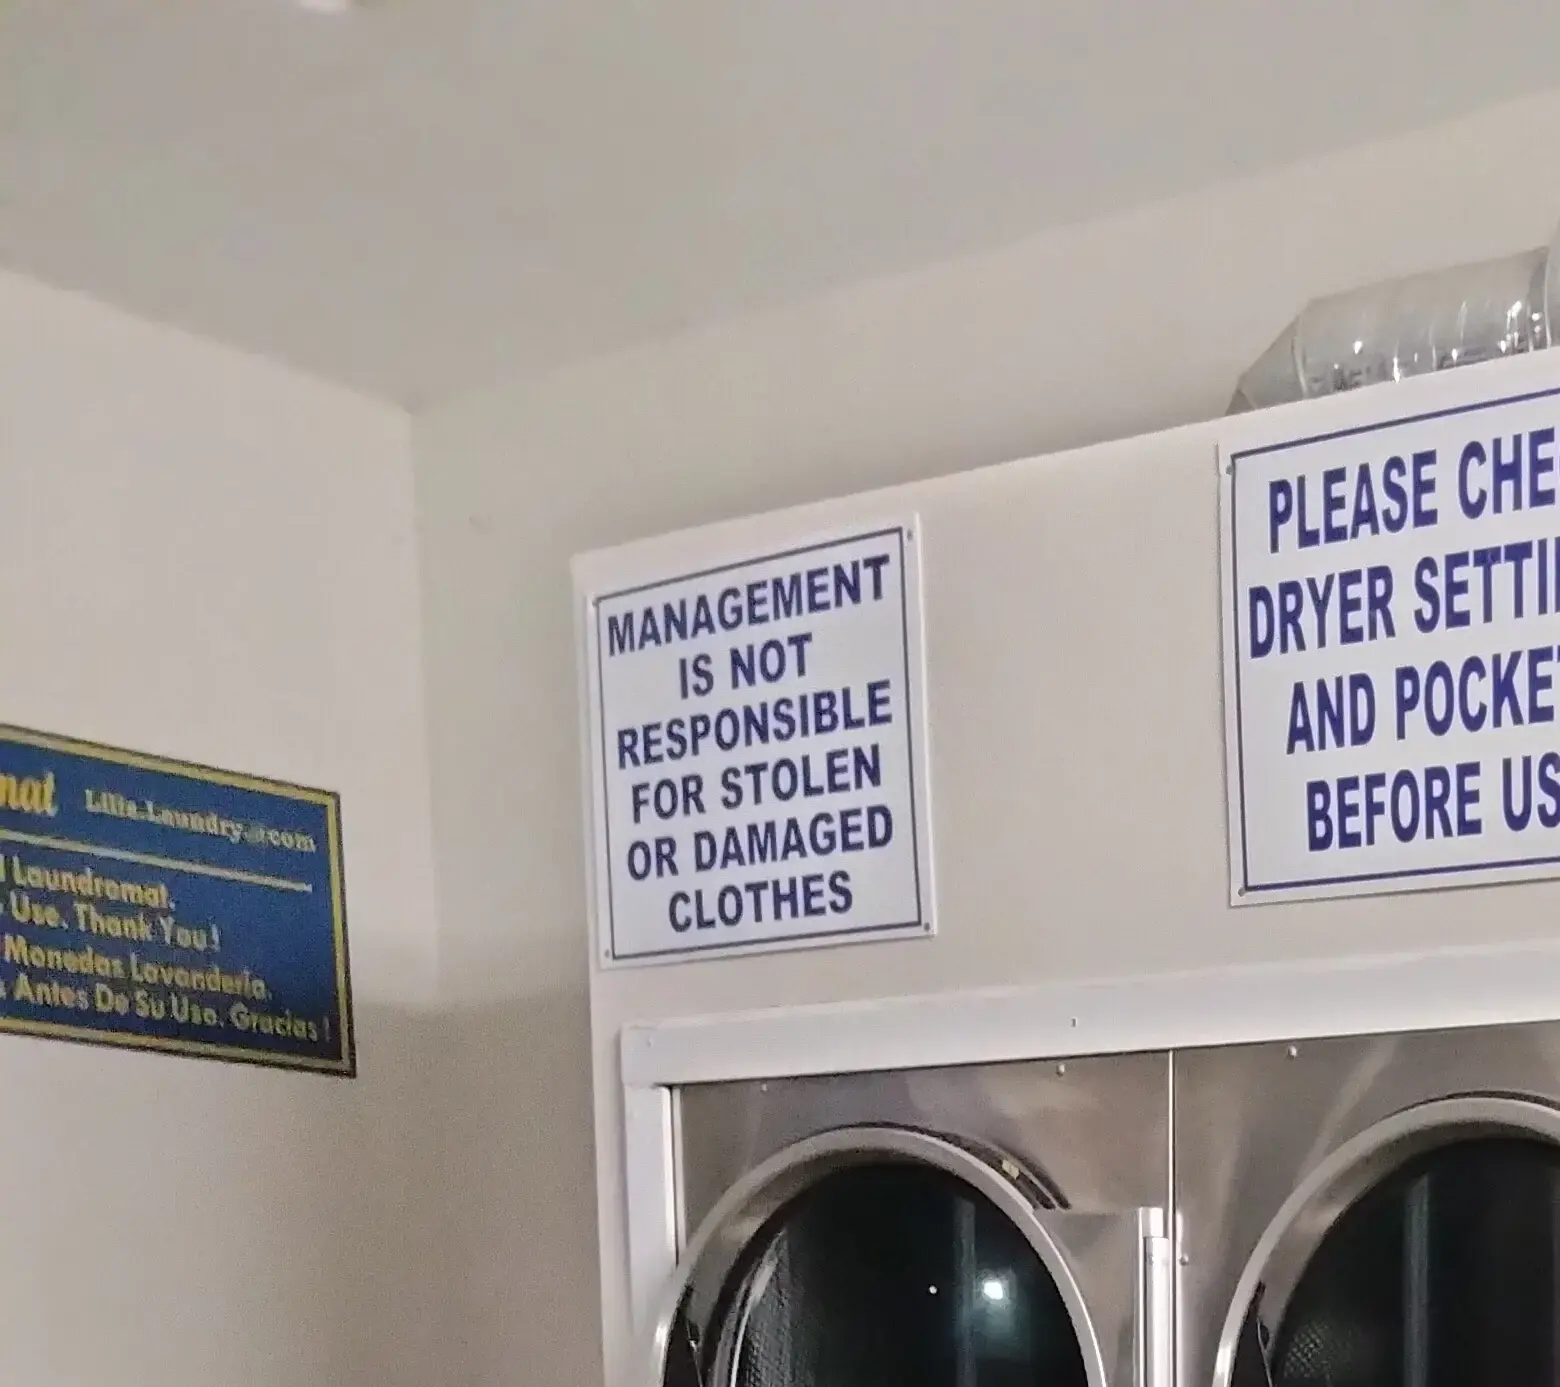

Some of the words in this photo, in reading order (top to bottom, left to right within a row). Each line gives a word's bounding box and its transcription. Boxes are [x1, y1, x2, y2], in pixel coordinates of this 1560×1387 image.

[1269, 449, 1438, 554] PLEASE
[607, 554, 890, 657] MANAGEMENT
[1248, 565, 1396, 660] DRYER
[679, 654, 714, 699] IS
[730, 633, 812, 690] NOT
[617, 679, 893, 769] RESPONSIBLE
[1286, 672, 1376, 756] AND
[632, 774, 706, 824] FOR
[721, 743, 882, 810] STOLEN
[1306, 761, 1483, 852] BEFORE
[627, 836, 678, 881] OR
[694, 804, 893, 872] DAMAGED
[74, 901, 153, 943] Thank
[668, 870, 853, 933] CLOTHES
[4, 933, 124, 980] Monedas
[14, 972, 91, 1010] Antes
[95, 983, 129, 1014] De
[135, 988, 165, 1020] Su
